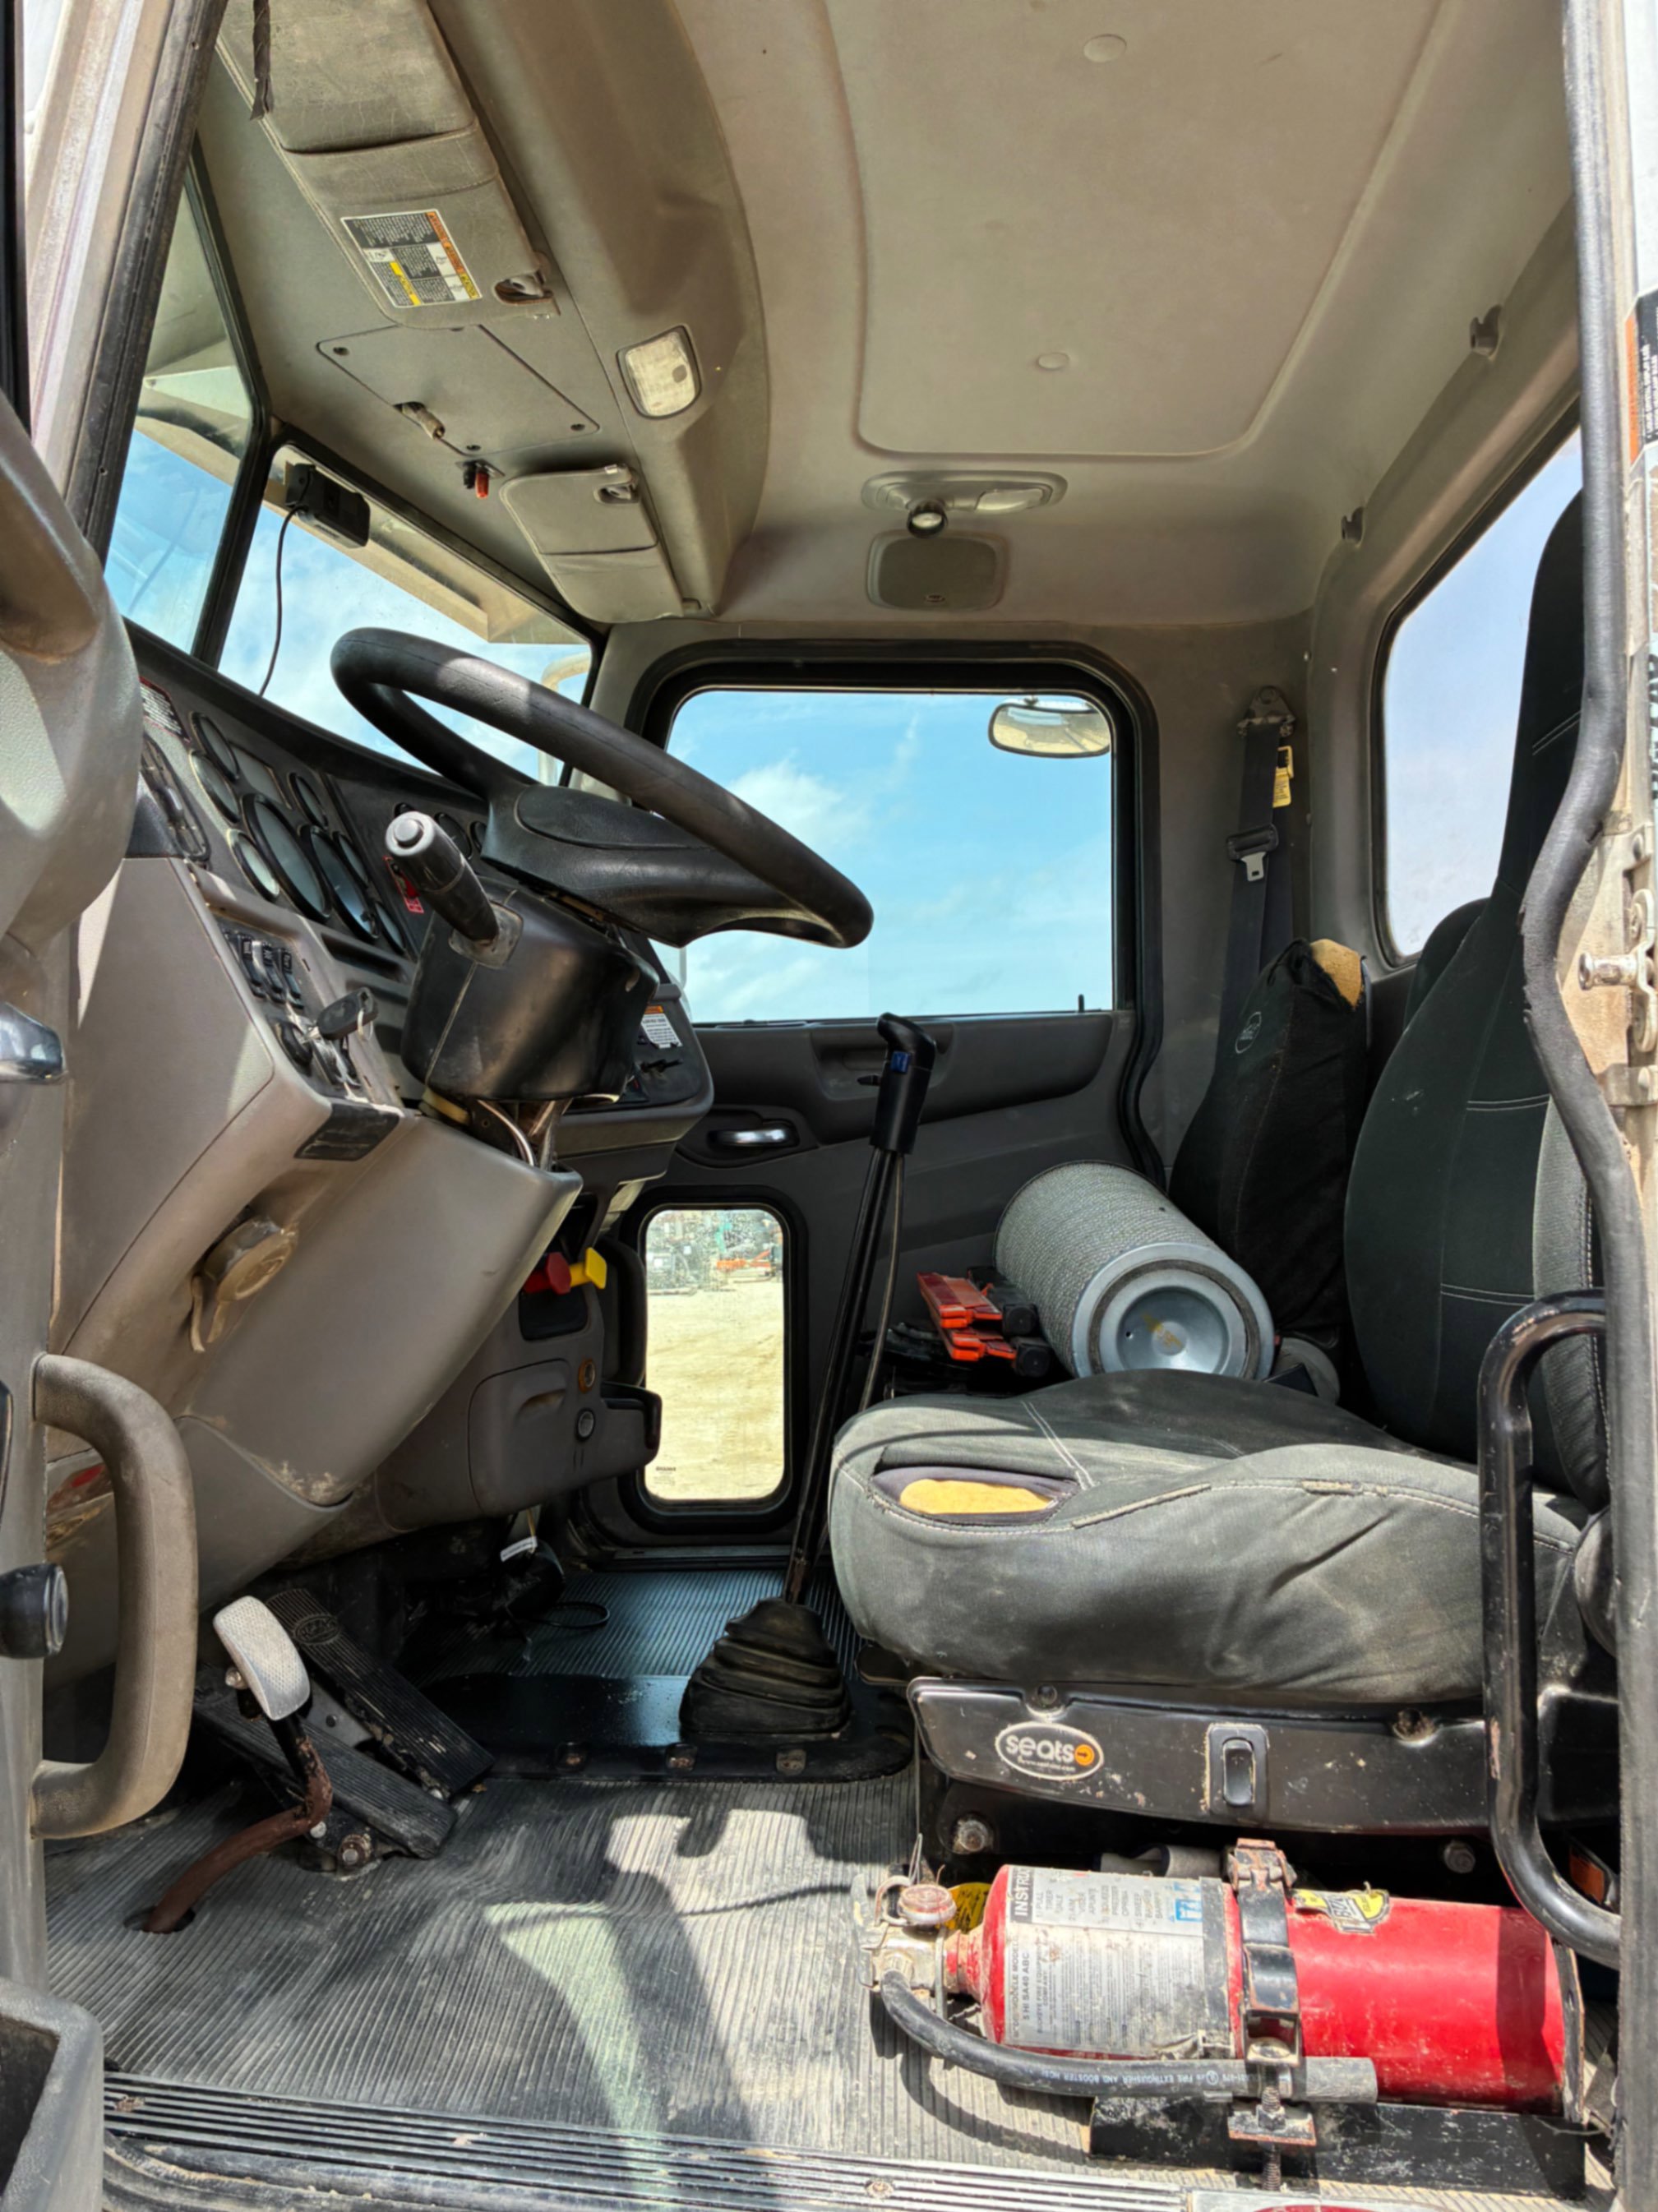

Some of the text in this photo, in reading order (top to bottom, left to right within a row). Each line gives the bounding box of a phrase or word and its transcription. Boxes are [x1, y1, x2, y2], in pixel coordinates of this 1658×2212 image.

[1005, 1734, 1075, 1764] seats
[1022, 1952, 1030, 1973] ABC
[1064, 2072, 1100, 2083] BOOSTER
[1102, 2074, 1117, 2084] AND
[1177, 2074, 1193, 2083] FIRE
